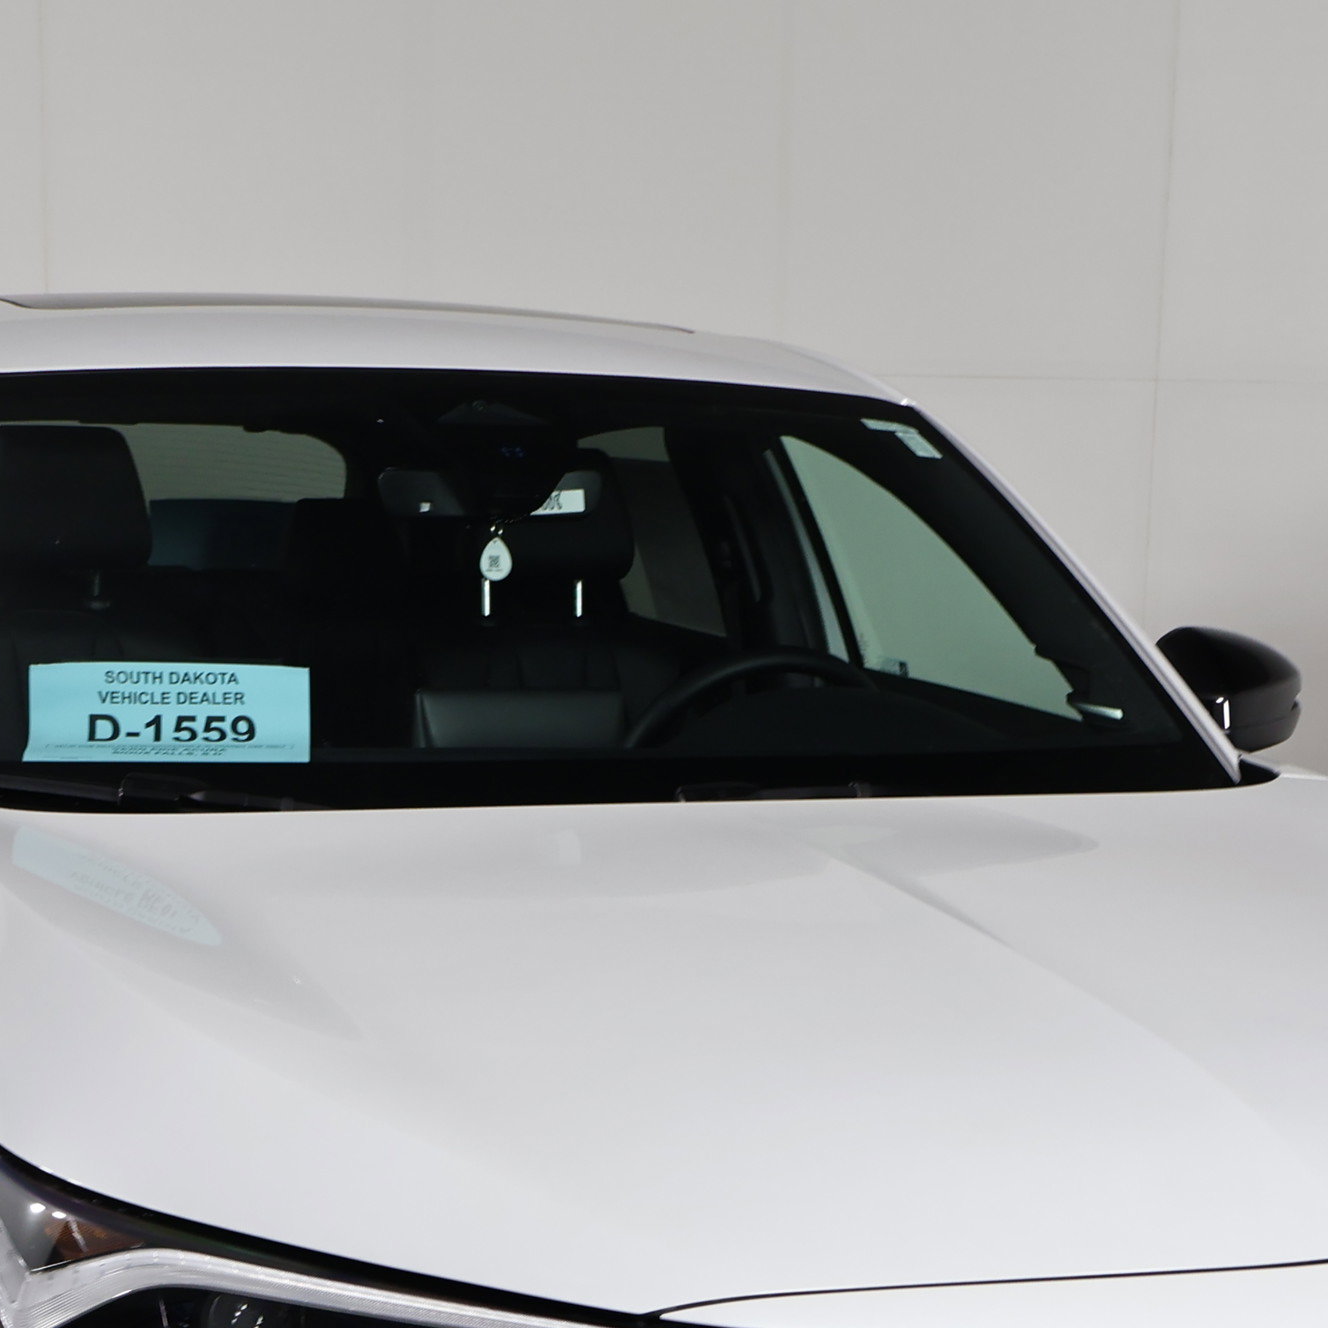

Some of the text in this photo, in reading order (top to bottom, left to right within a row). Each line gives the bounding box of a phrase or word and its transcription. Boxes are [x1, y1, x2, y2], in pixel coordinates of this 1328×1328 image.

[105, 671, 239, 685] SOUTH DAKOTA
[98, 691, 245, 705] VEHICLE DEALER
[87, 713, 256, 742] D-1559
